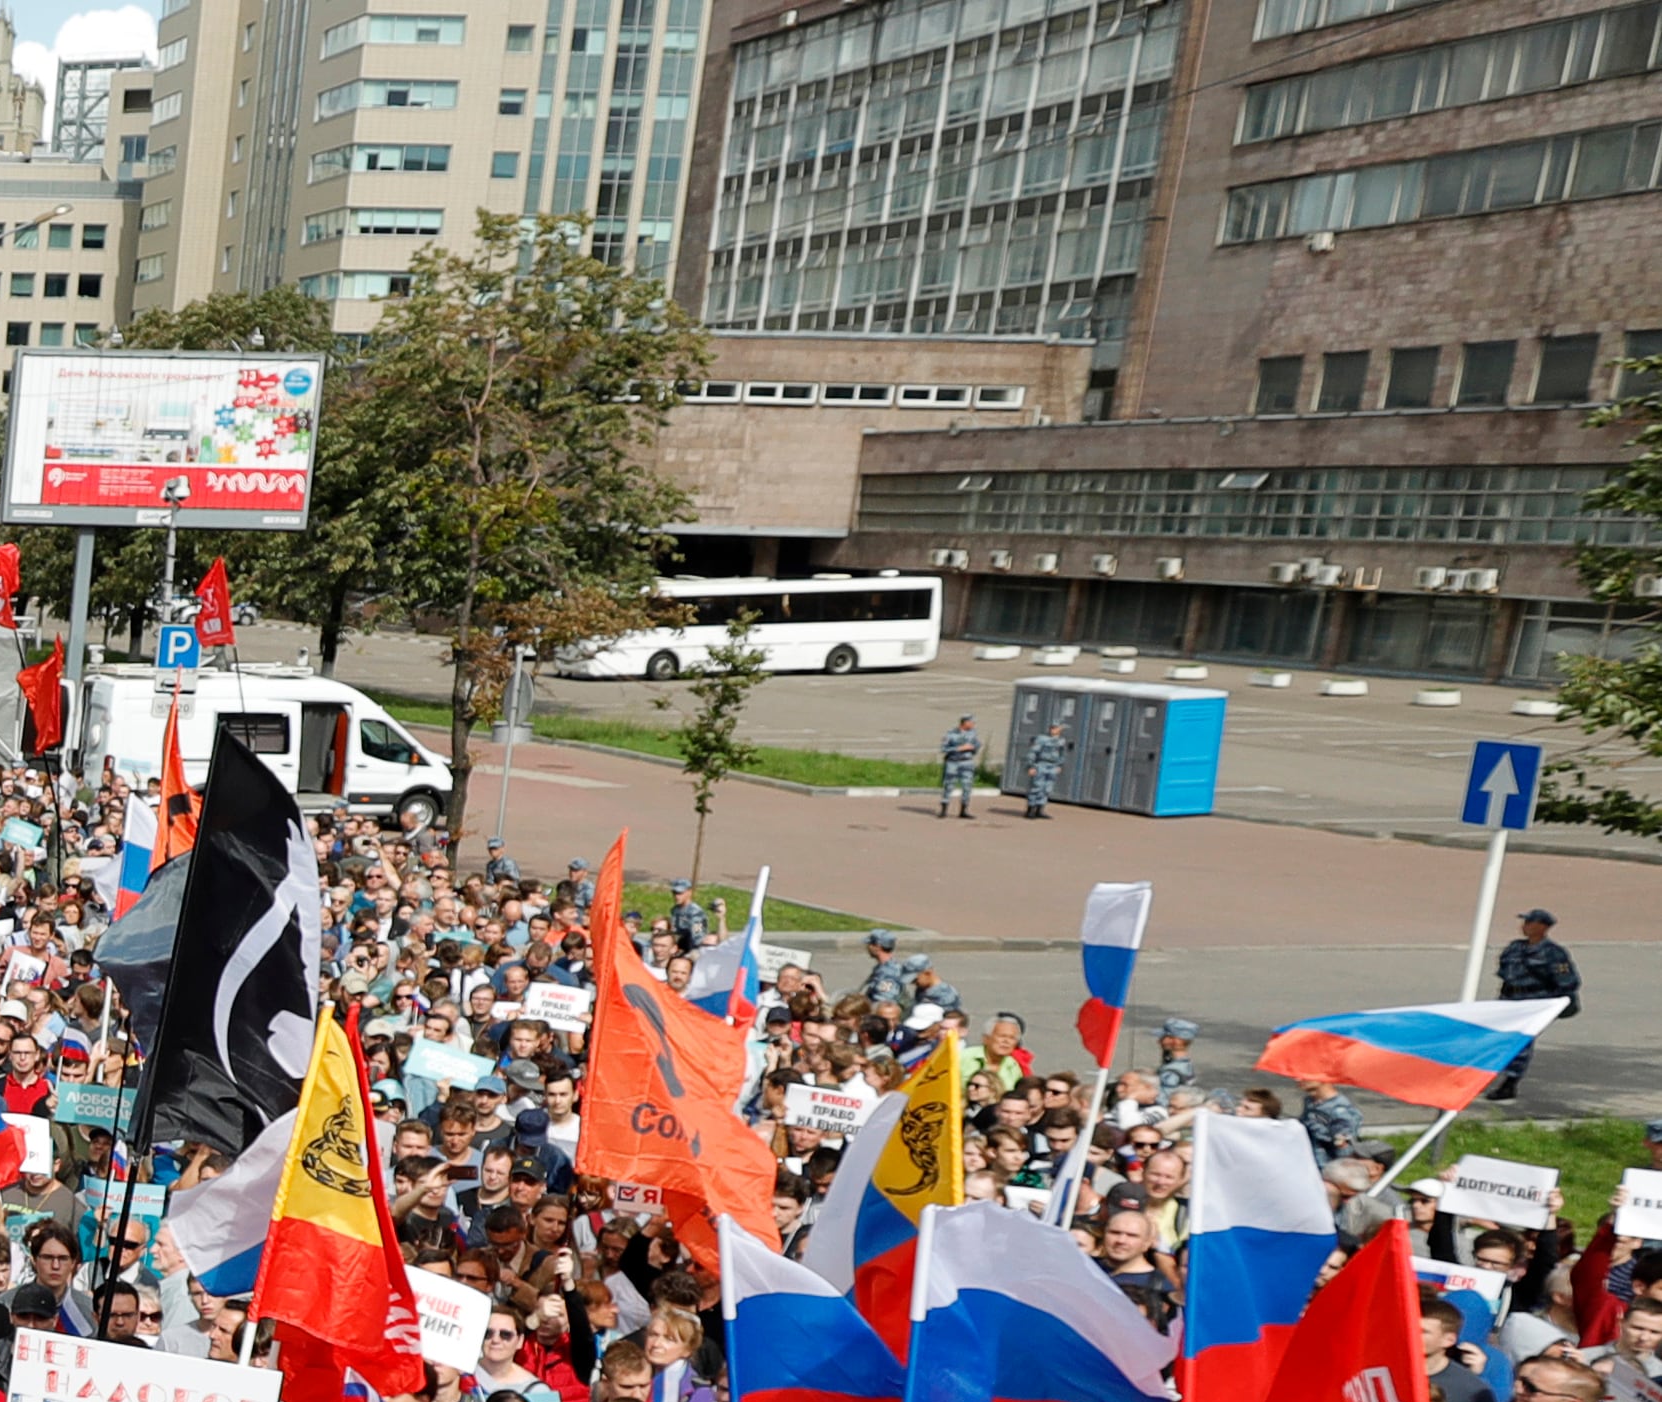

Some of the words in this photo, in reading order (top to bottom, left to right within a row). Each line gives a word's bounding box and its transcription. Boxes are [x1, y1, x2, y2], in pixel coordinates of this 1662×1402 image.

[169, 631, 190, 664] P
[796, 1116, 814, 1128] НА
[813, 1105, 856, 1121] ПРАВО
[1456, 1175, 1542, 1203] ДОПУСКАЙ!
[19, 1334, 91, 1370] НЕТ
